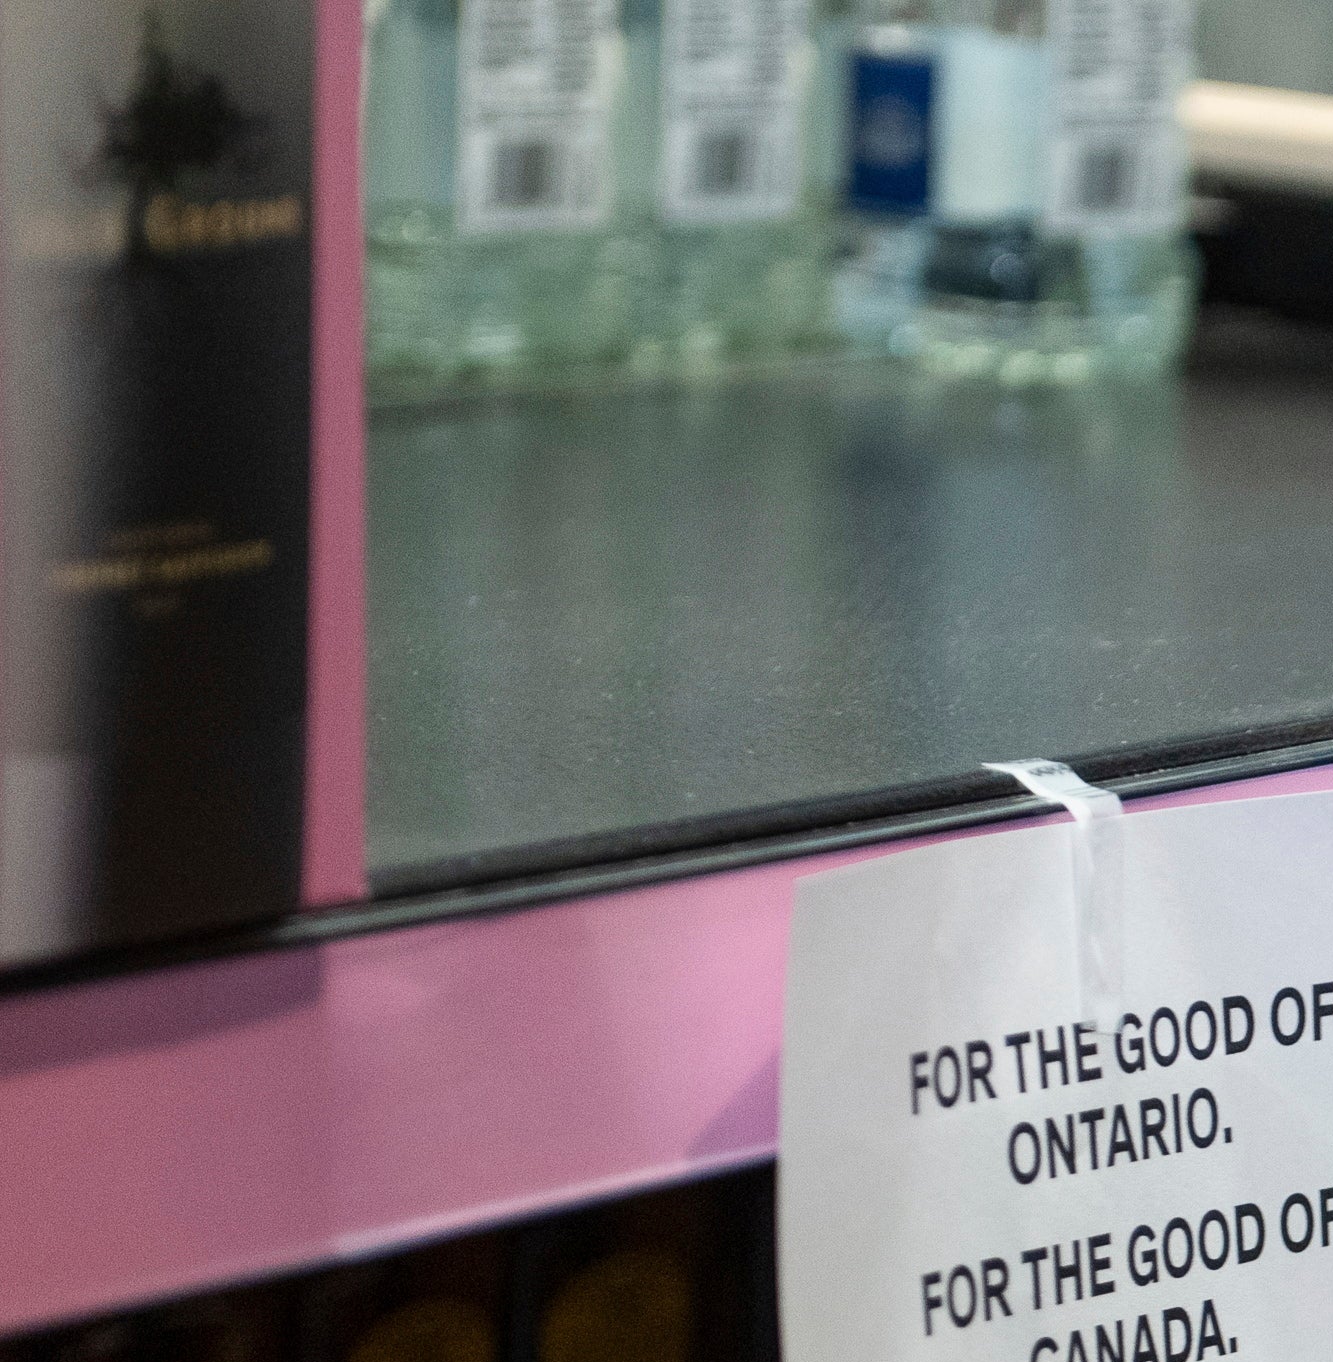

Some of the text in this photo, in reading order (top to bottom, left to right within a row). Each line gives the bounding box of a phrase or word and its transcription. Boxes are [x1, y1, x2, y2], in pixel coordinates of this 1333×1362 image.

[909, 1039, 998, 1115] FOR
[1004, 1022, 1103, 1093] THE
[1113, 995, 1256, 1074] GOOD
[1007, 1087, 1233, 1186] ONTARIO.
[921, 1257, 1014, 1337] FOR
[1020, 1232, 1116, 1311] THE
[1127, 1202, 1266, 1287] GOOD
